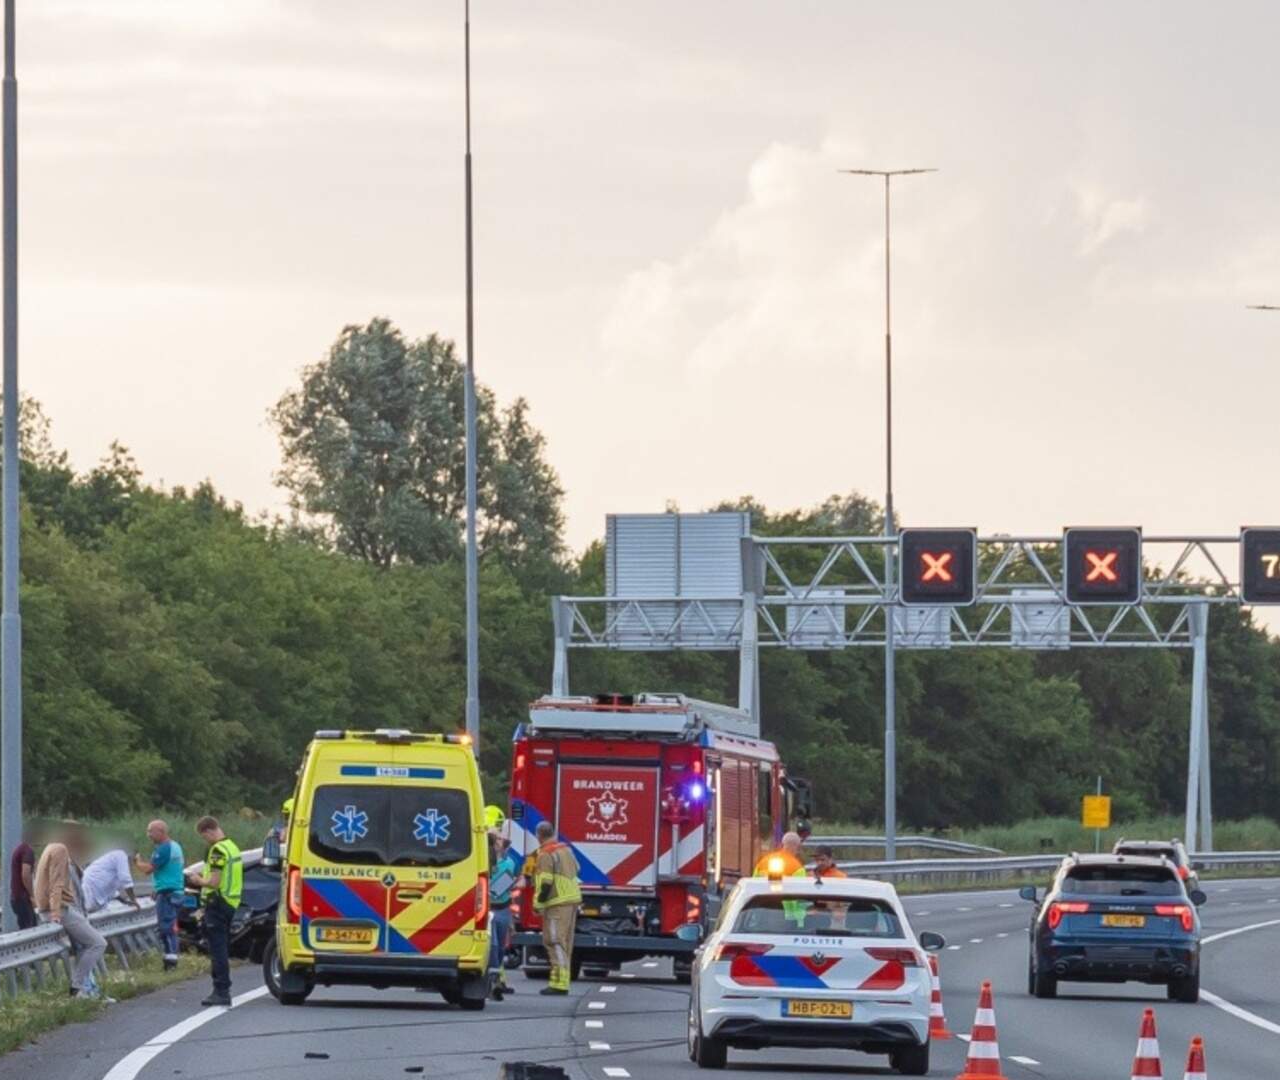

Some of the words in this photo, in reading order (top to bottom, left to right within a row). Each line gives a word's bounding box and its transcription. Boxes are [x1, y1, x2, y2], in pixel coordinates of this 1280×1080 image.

[572, 780, 645, 791] BRANDWEER
[303, 866, 381, 878] AMBULANCE
[793, 937, 843, 945] POLITIE
